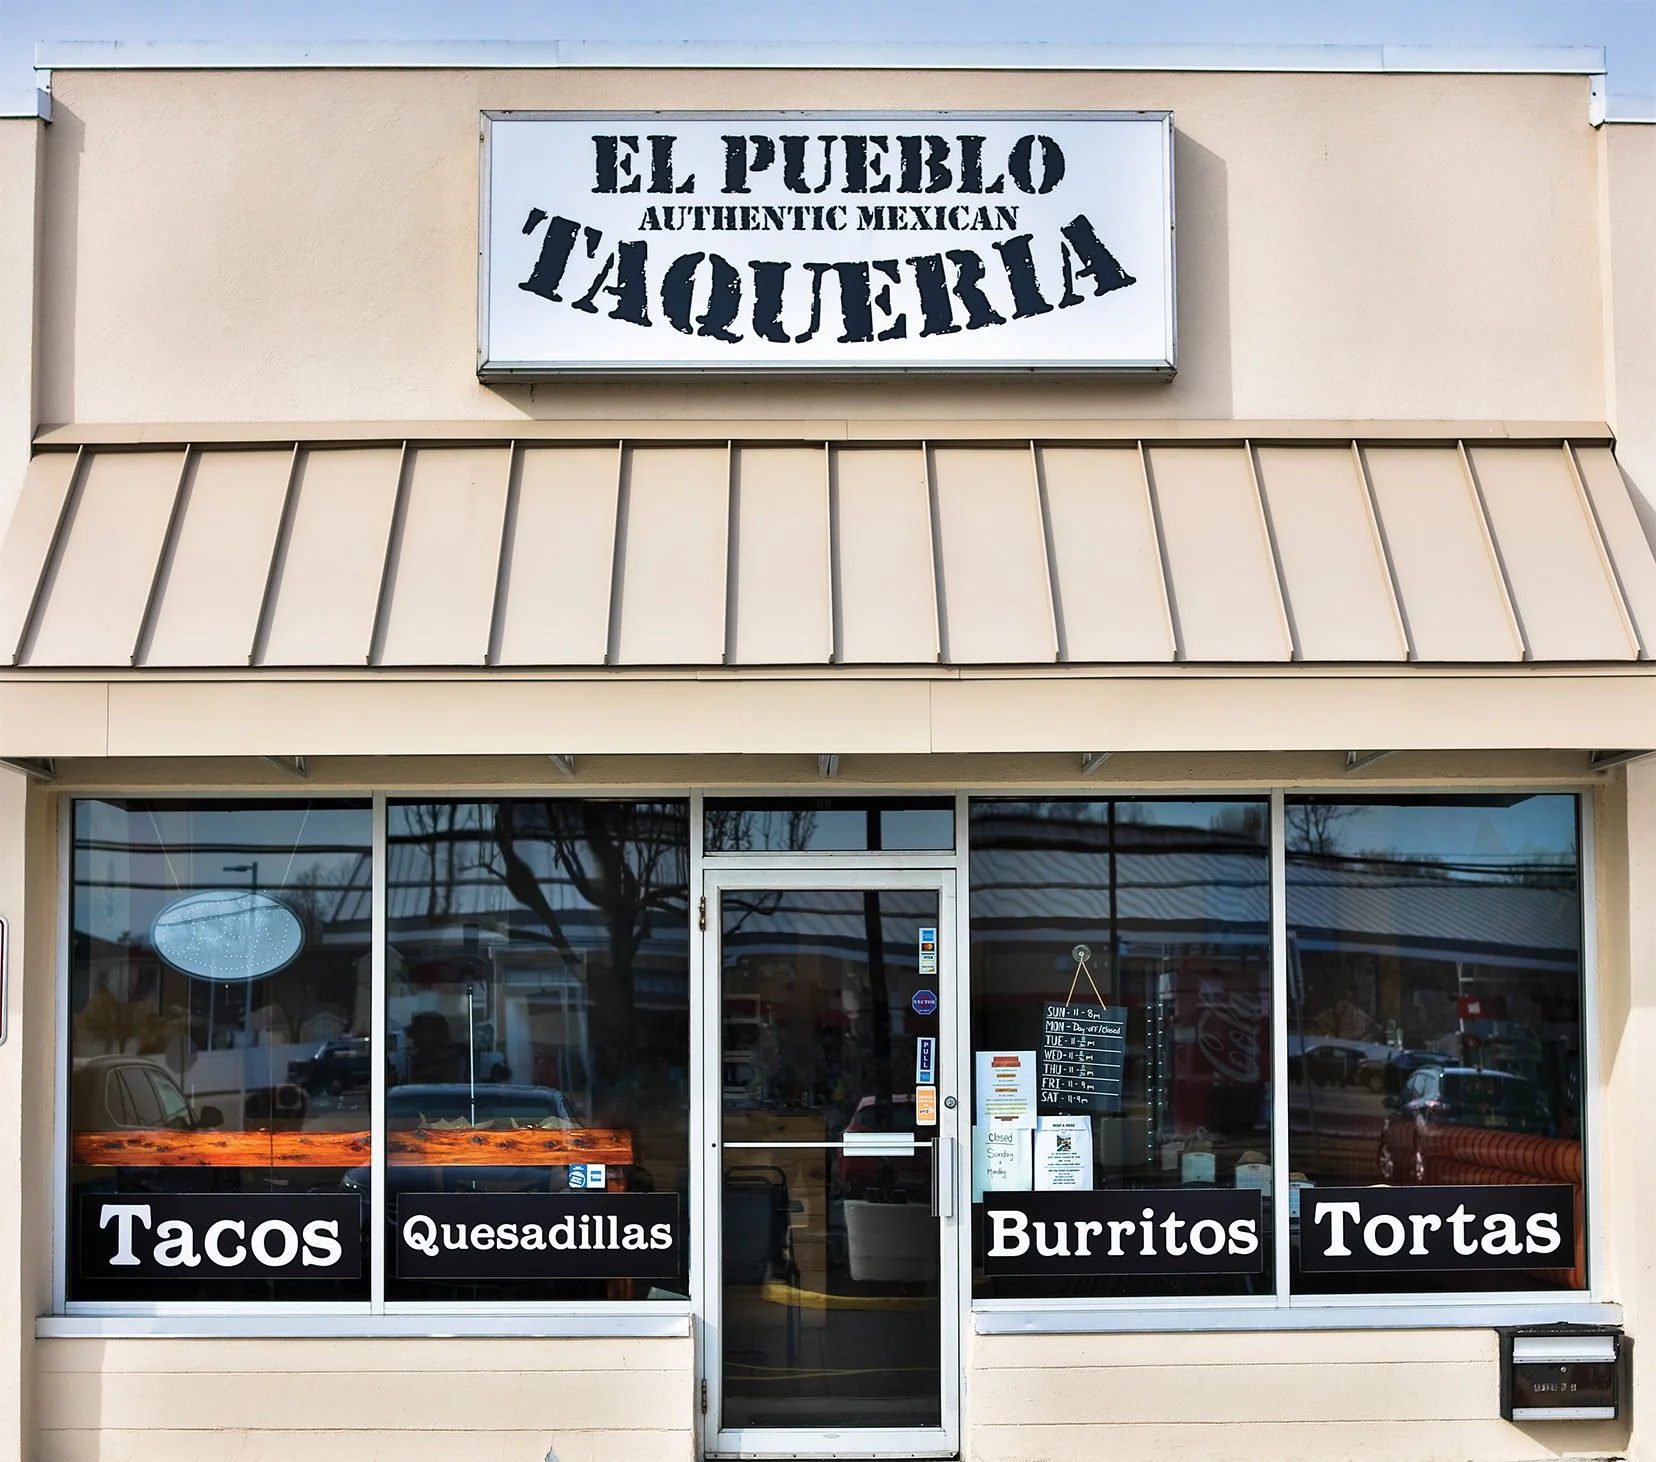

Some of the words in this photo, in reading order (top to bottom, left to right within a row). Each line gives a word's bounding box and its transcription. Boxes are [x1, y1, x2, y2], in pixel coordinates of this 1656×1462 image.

[591, 135, 695, 194] EL
[721, 135, 1066, 194] PUEBLO
[638, 206, 848, 231] AUTHENTIC
[857, 206, 1019, 231] MEXICAN
[518, 208, 1137, 344] TAQUERIA
[987, 1148, 1014, 1161] Sunday
[988, 1132, 1013, 1142] Closed
[987, 1168, 1007, 1179] Monday
[100, 1204, 342, 1267] Tacos
[403, 1214, 673, 1257] Quesadillas
[987, 1207, 1259, 1257] Burritos
[1314, 1201, 1561, 1257] Tortas
